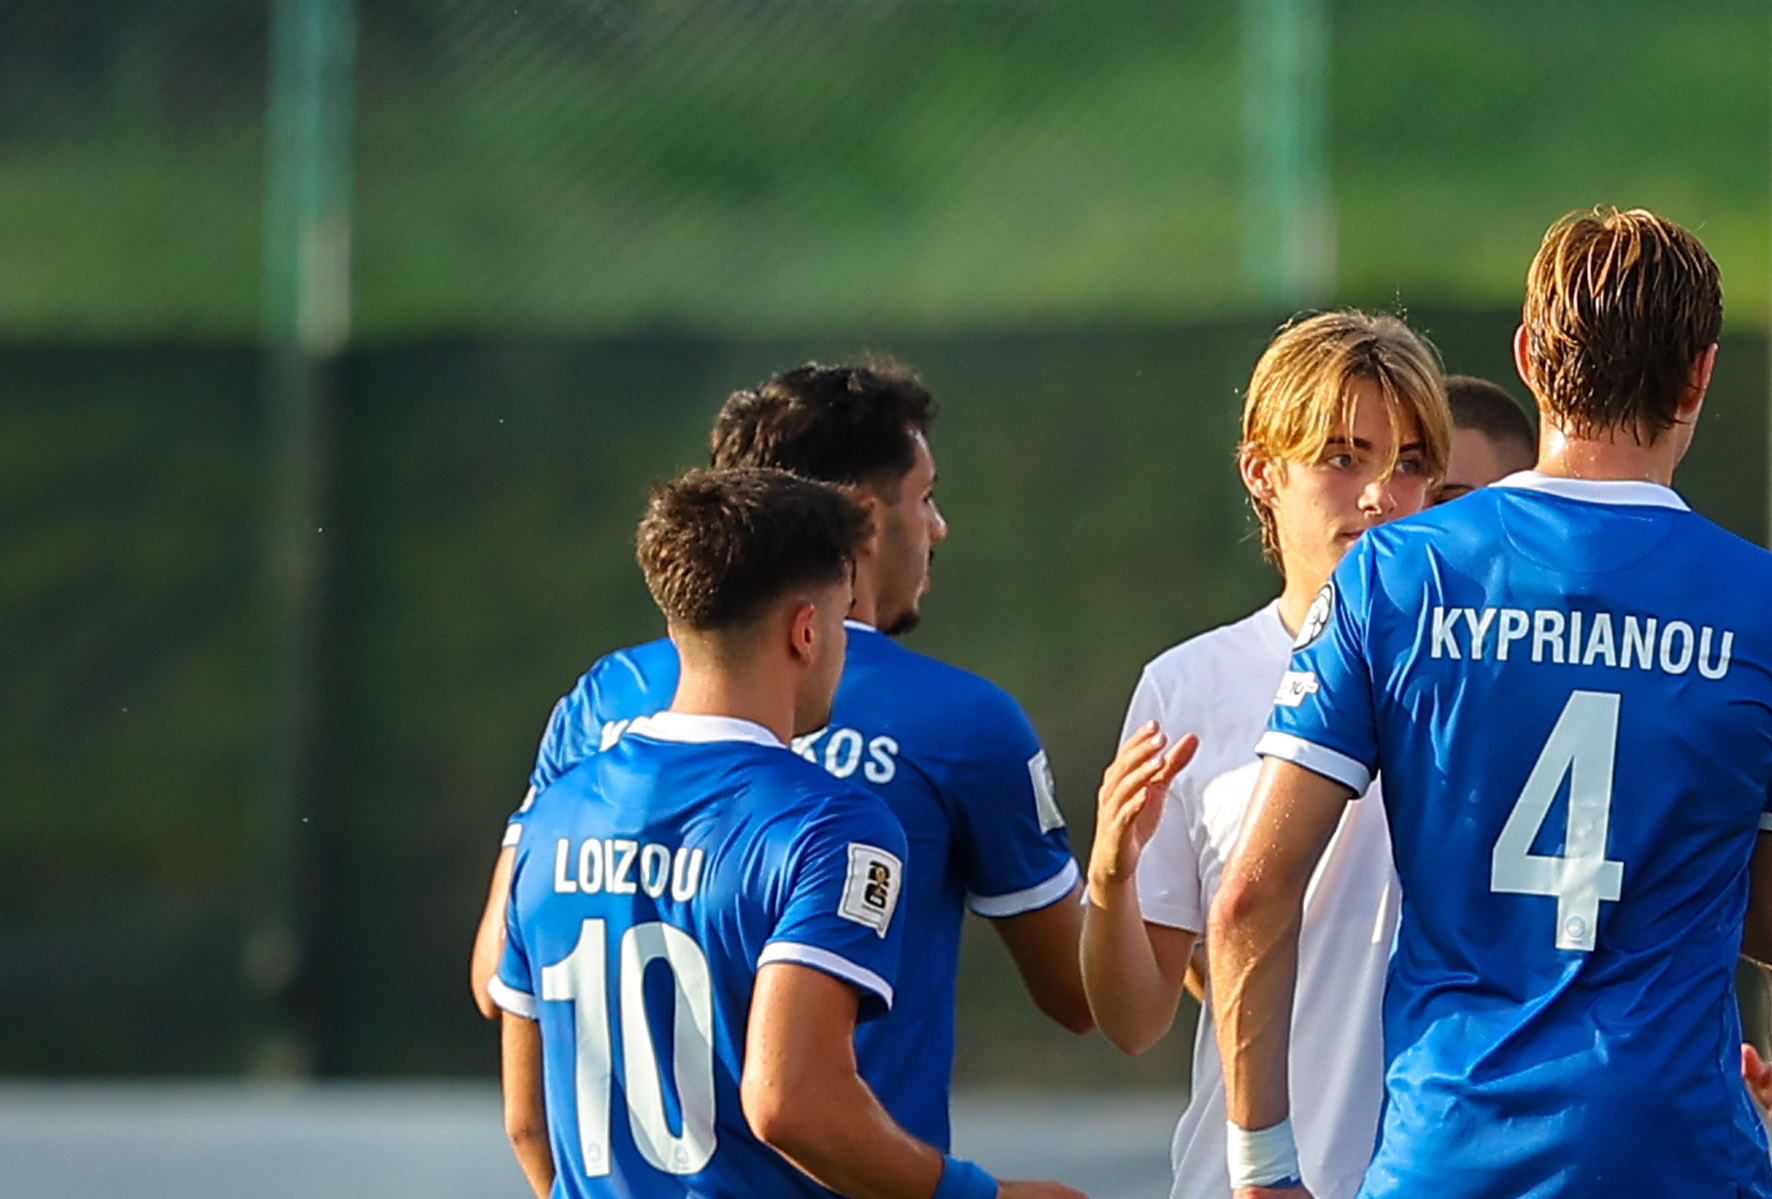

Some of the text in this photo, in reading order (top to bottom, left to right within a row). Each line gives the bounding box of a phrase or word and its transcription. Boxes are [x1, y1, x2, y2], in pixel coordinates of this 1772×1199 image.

[1430, 605, 1735, 680] KYPRIANOU
[553, 838, 705, 902] LOIZOU
[1489, 689, 1625, 952] 4
[541, 917, 719, 1178] 10
